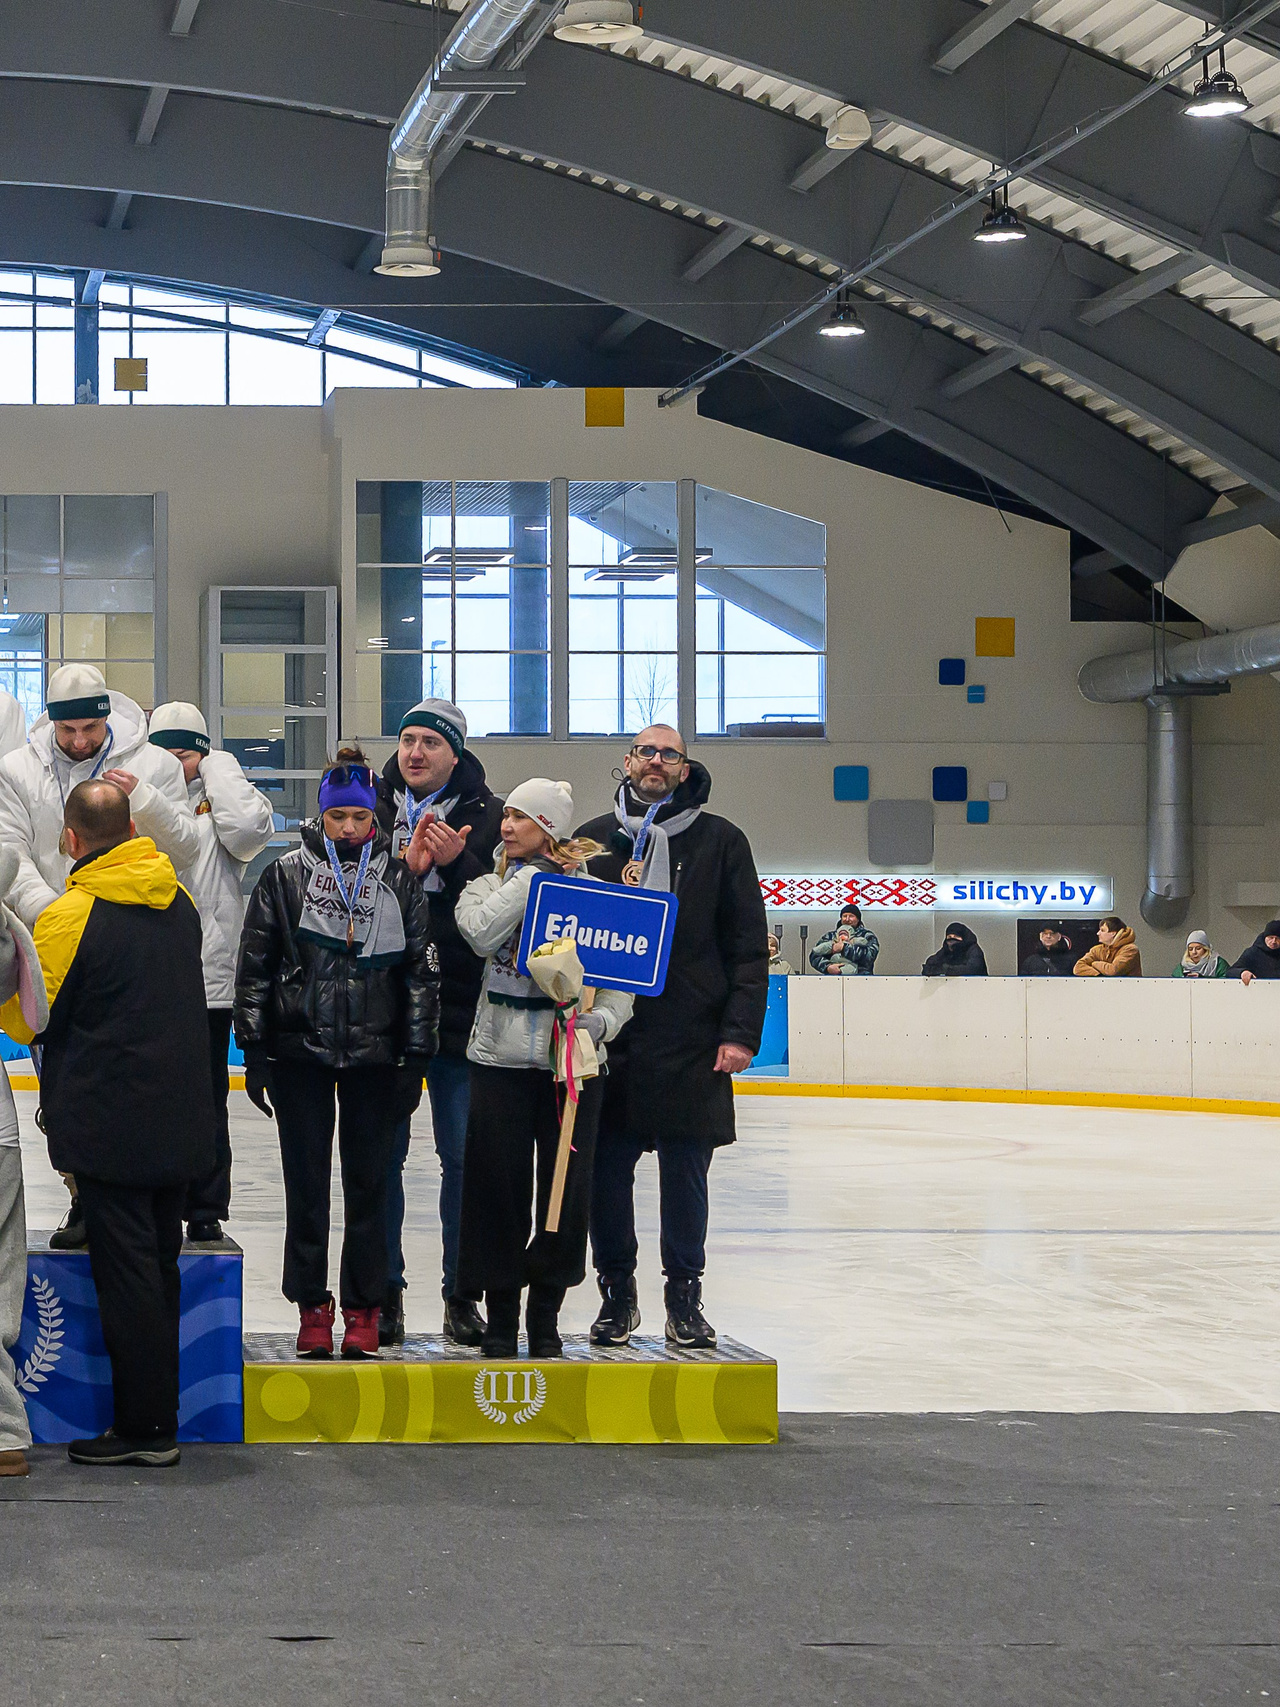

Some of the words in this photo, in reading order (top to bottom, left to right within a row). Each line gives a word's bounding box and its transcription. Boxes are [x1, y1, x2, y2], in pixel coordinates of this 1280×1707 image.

[953, 880, 1096, 905] silichy.by
[544, 913, 649, 956] Единые
[486, 1371, 534, 1403] III
